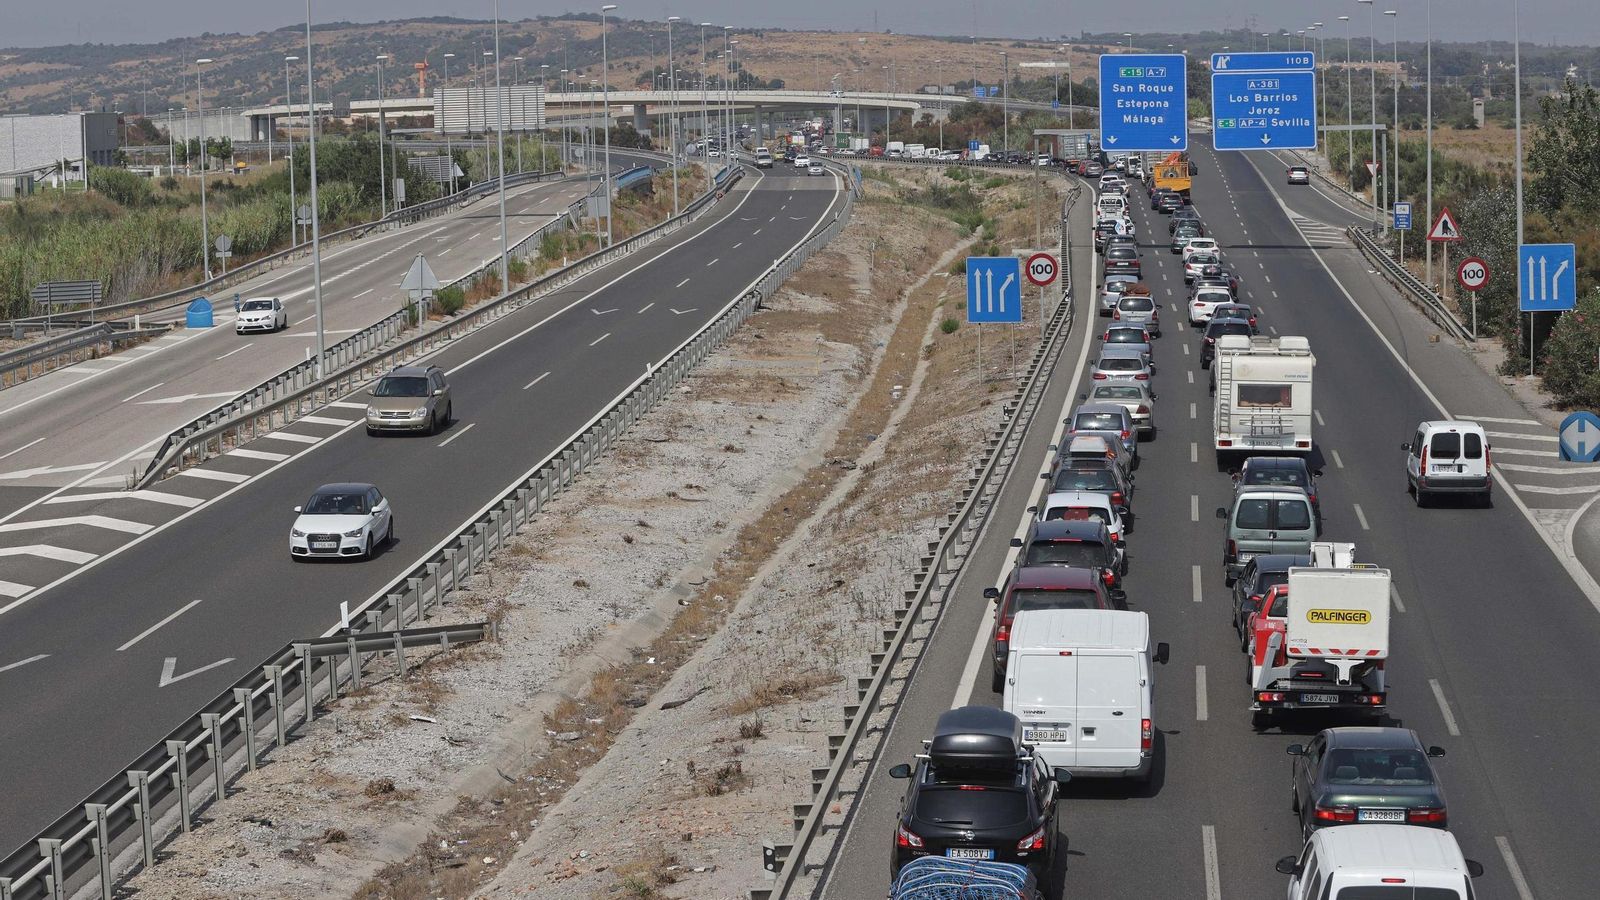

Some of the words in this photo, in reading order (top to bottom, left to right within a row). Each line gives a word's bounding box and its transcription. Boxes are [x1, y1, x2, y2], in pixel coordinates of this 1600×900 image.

[1112, 84, 1133, 92] San
[1138, 84, 1174, 94] Roque
[1229, 94, 1249, 103] Los
[1254, 93, 1298, 102] Barrios
[1117, 99, 1169, 109] Estepona
[1248, 107, 1280, 115] Jerez
[1123, 115, 1163, 125] Málaga
[1218, 119, 1235, 127] E-5
[1240, 119, 1266, 127] AP-4
[1271, 118, 1310, 127] Sevilla
[1031, 264, 1053, 275] 100
[1463, 269, 1484, 279] 100
[1311, 611, 1367, 622] PALFINGER
